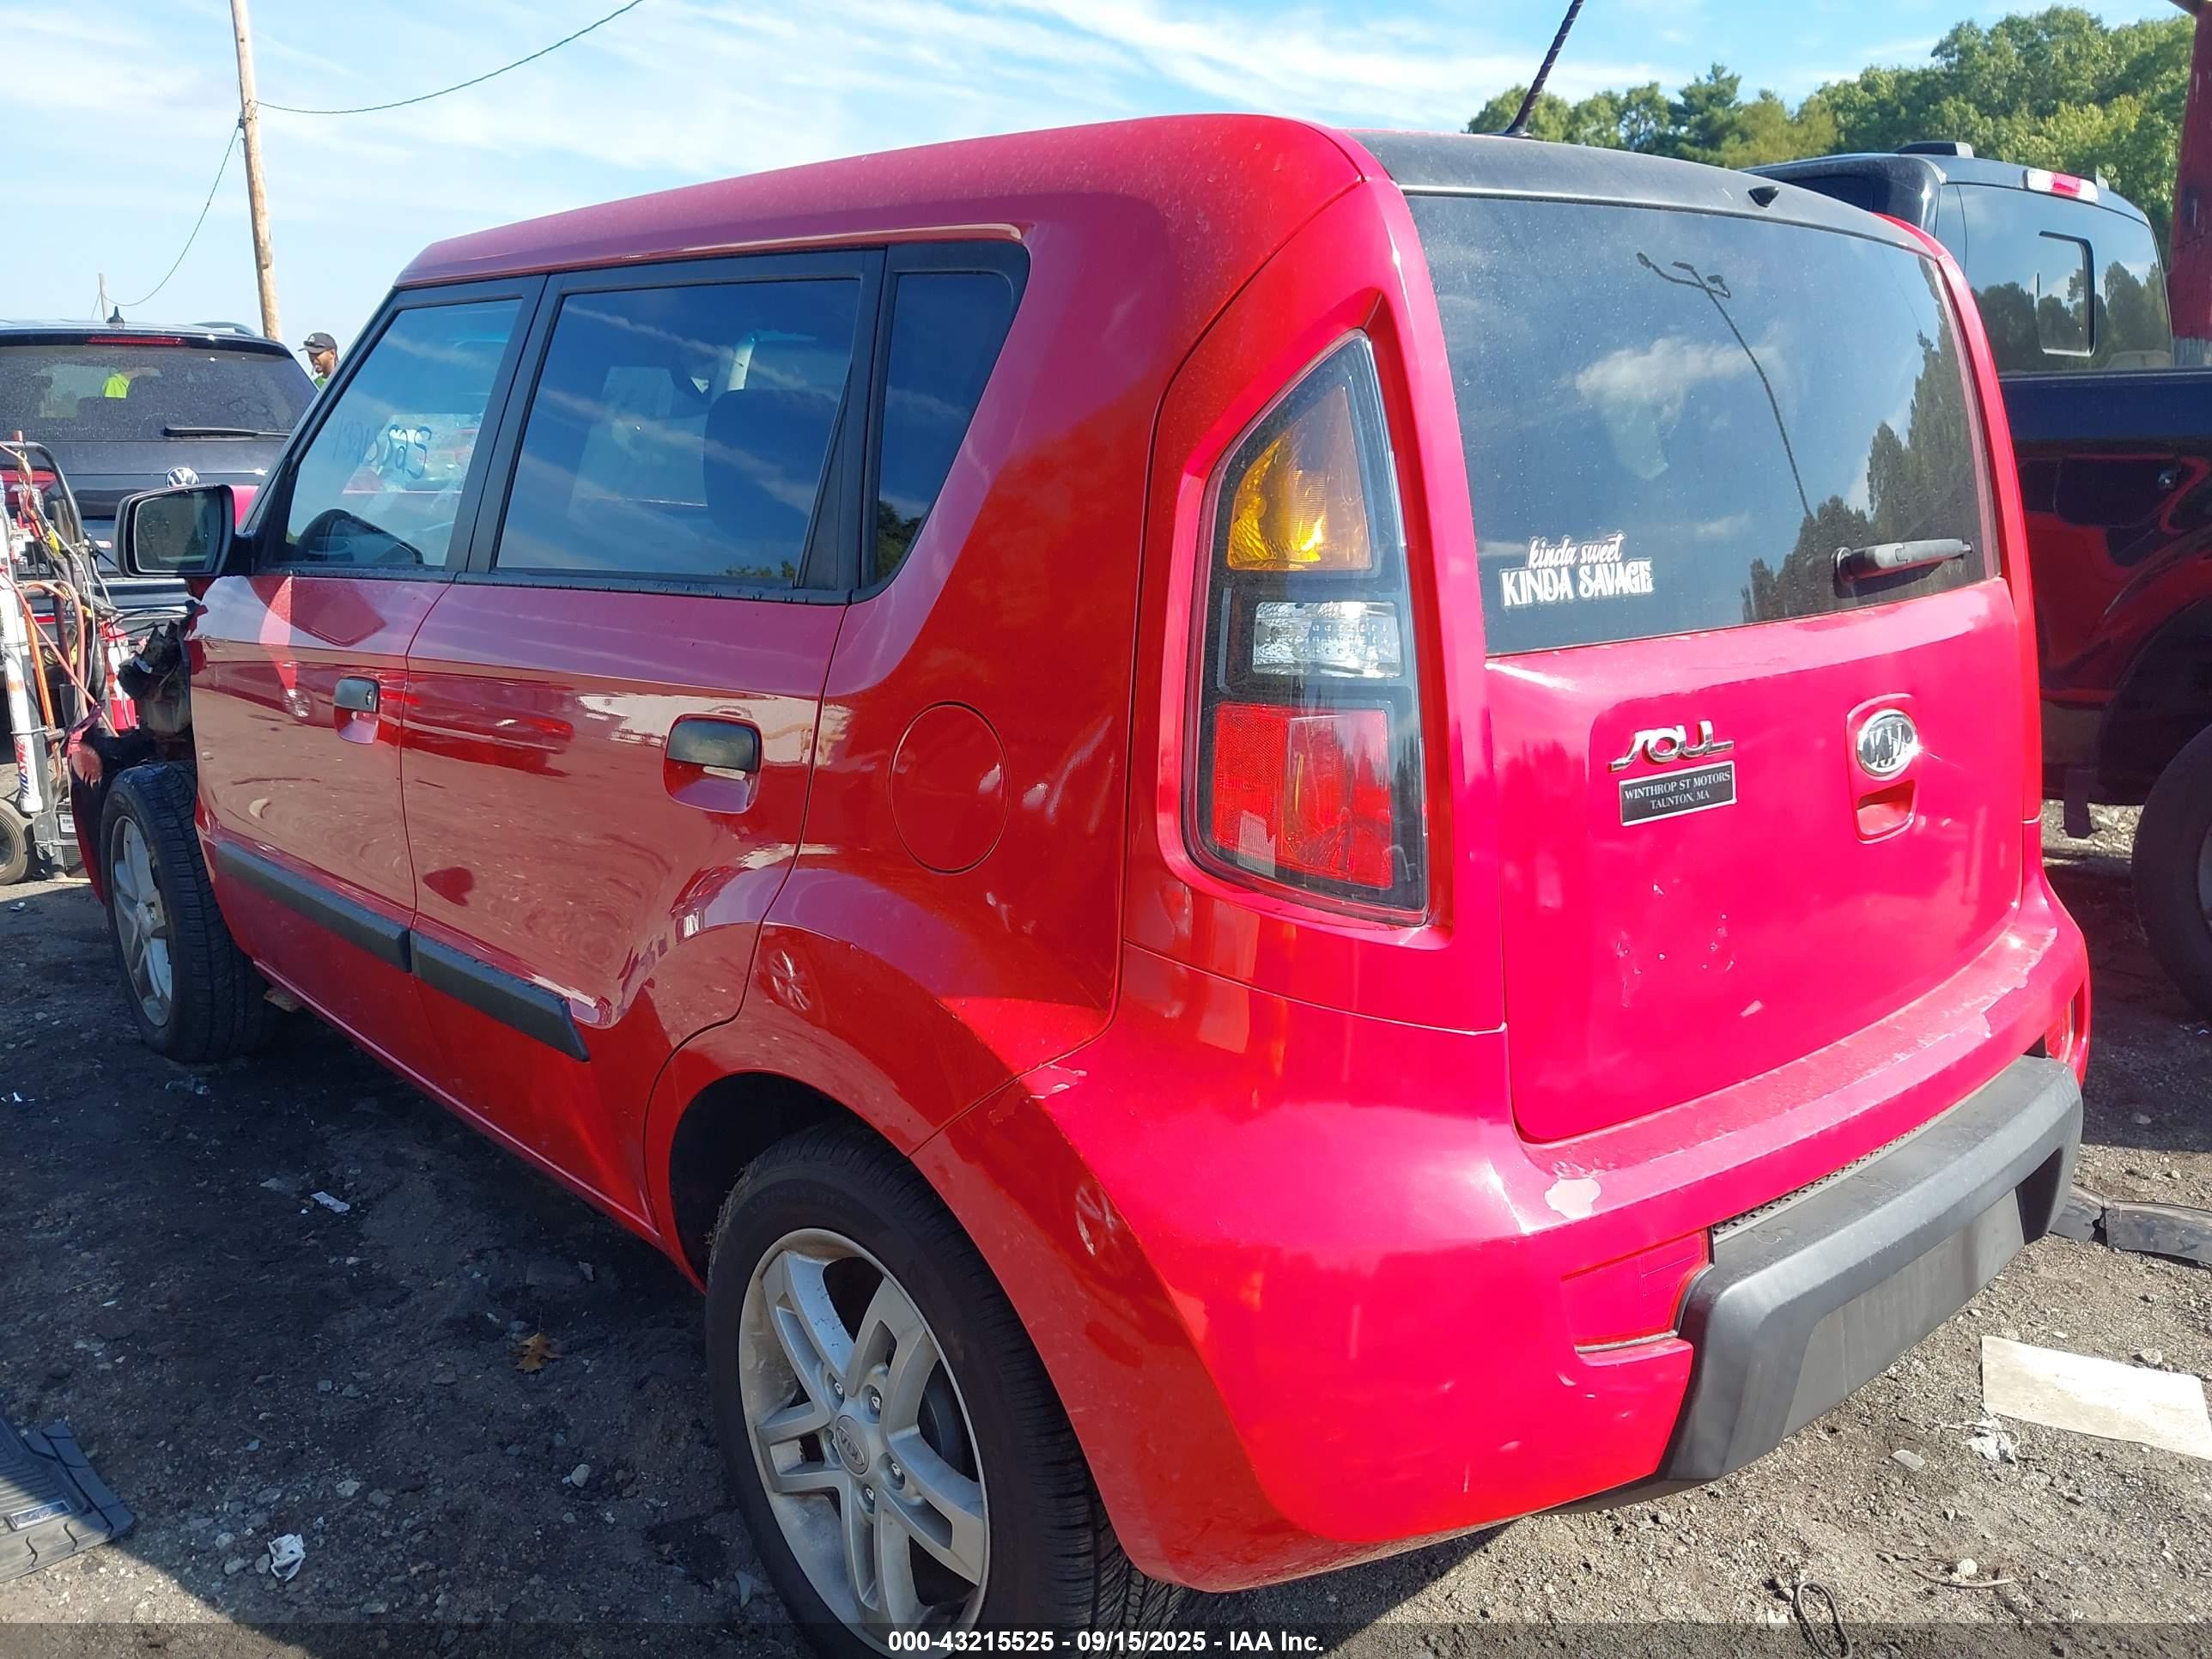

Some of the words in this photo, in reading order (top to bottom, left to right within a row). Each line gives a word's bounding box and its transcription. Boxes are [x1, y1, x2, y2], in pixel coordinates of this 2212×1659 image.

[1528, 538, 1577, 568] kinda
[1581, 532, 1626, 563] sweet
[1501, 566, 1575, 606] KINDA
[1578, 560, 1655, 599] SAVAGE
[1608, 720, 1735, 772] SOUL
[1624, 781, 1678, 799] WINTHROP
[1679, 778, 1692, 791] ST
[1692, 770, 1731, 787] MOTORS
[1696, 789, 1711, 801] MA
